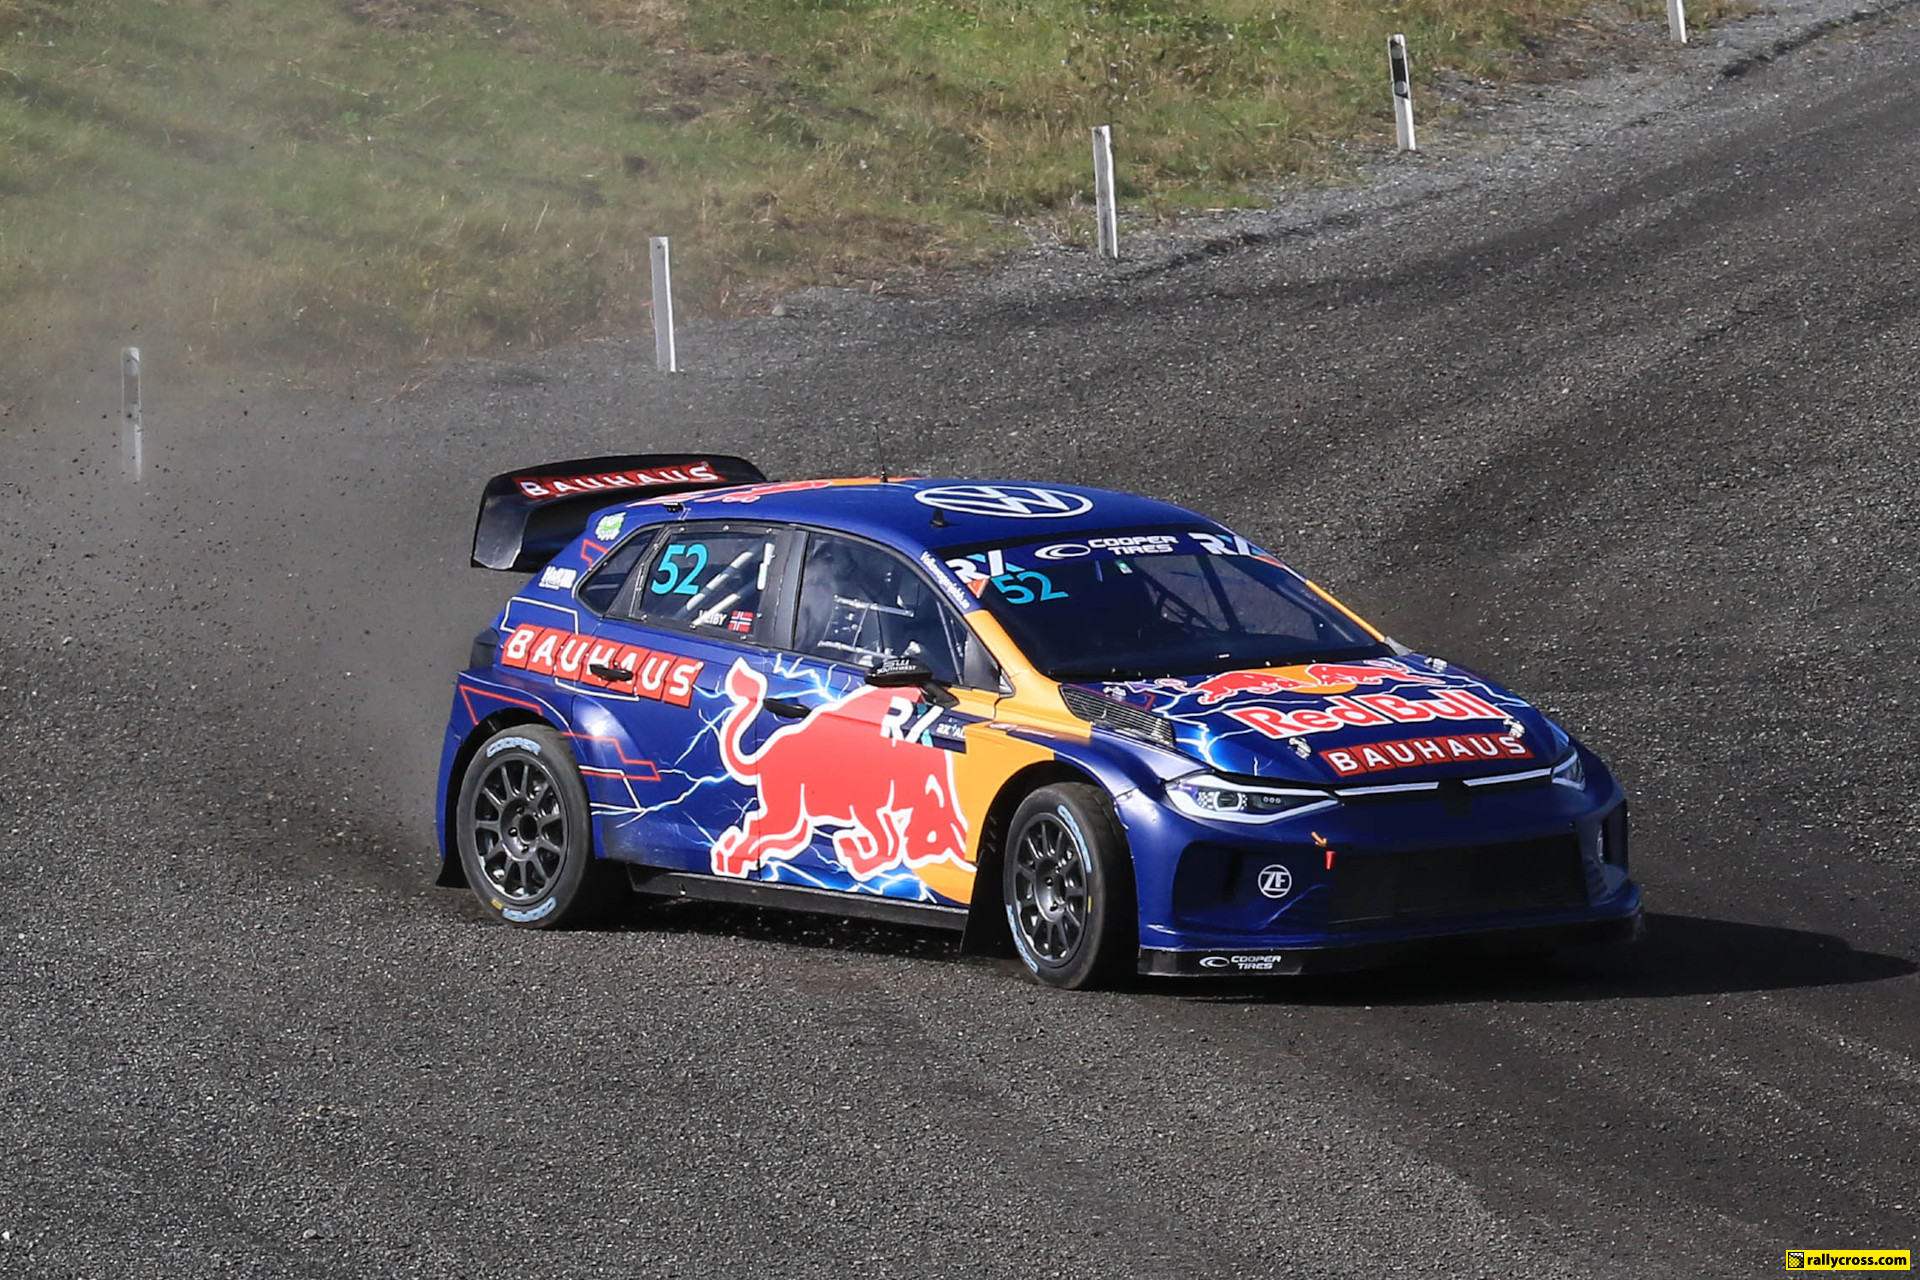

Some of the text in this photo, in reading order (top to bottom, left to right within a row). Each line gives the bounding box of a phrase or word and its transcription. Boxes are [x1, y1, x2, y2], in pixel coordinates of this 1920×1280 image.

[521, 466, 719, 497] BAUHAUS
[1088, 536, 1179, 549] COOPER
[1107, 544, 1173, 556] TIRES
[651, 544, 708, 595] 52
[991, 571, 1069, 604] 52
[1328, 735, 1526, 772] BAUHAUS
[1259, 868, 1290, 894] ZF
[1231, 955, 1282, 963] COOPER
[1237, 962, 1274, 970] TIRES
